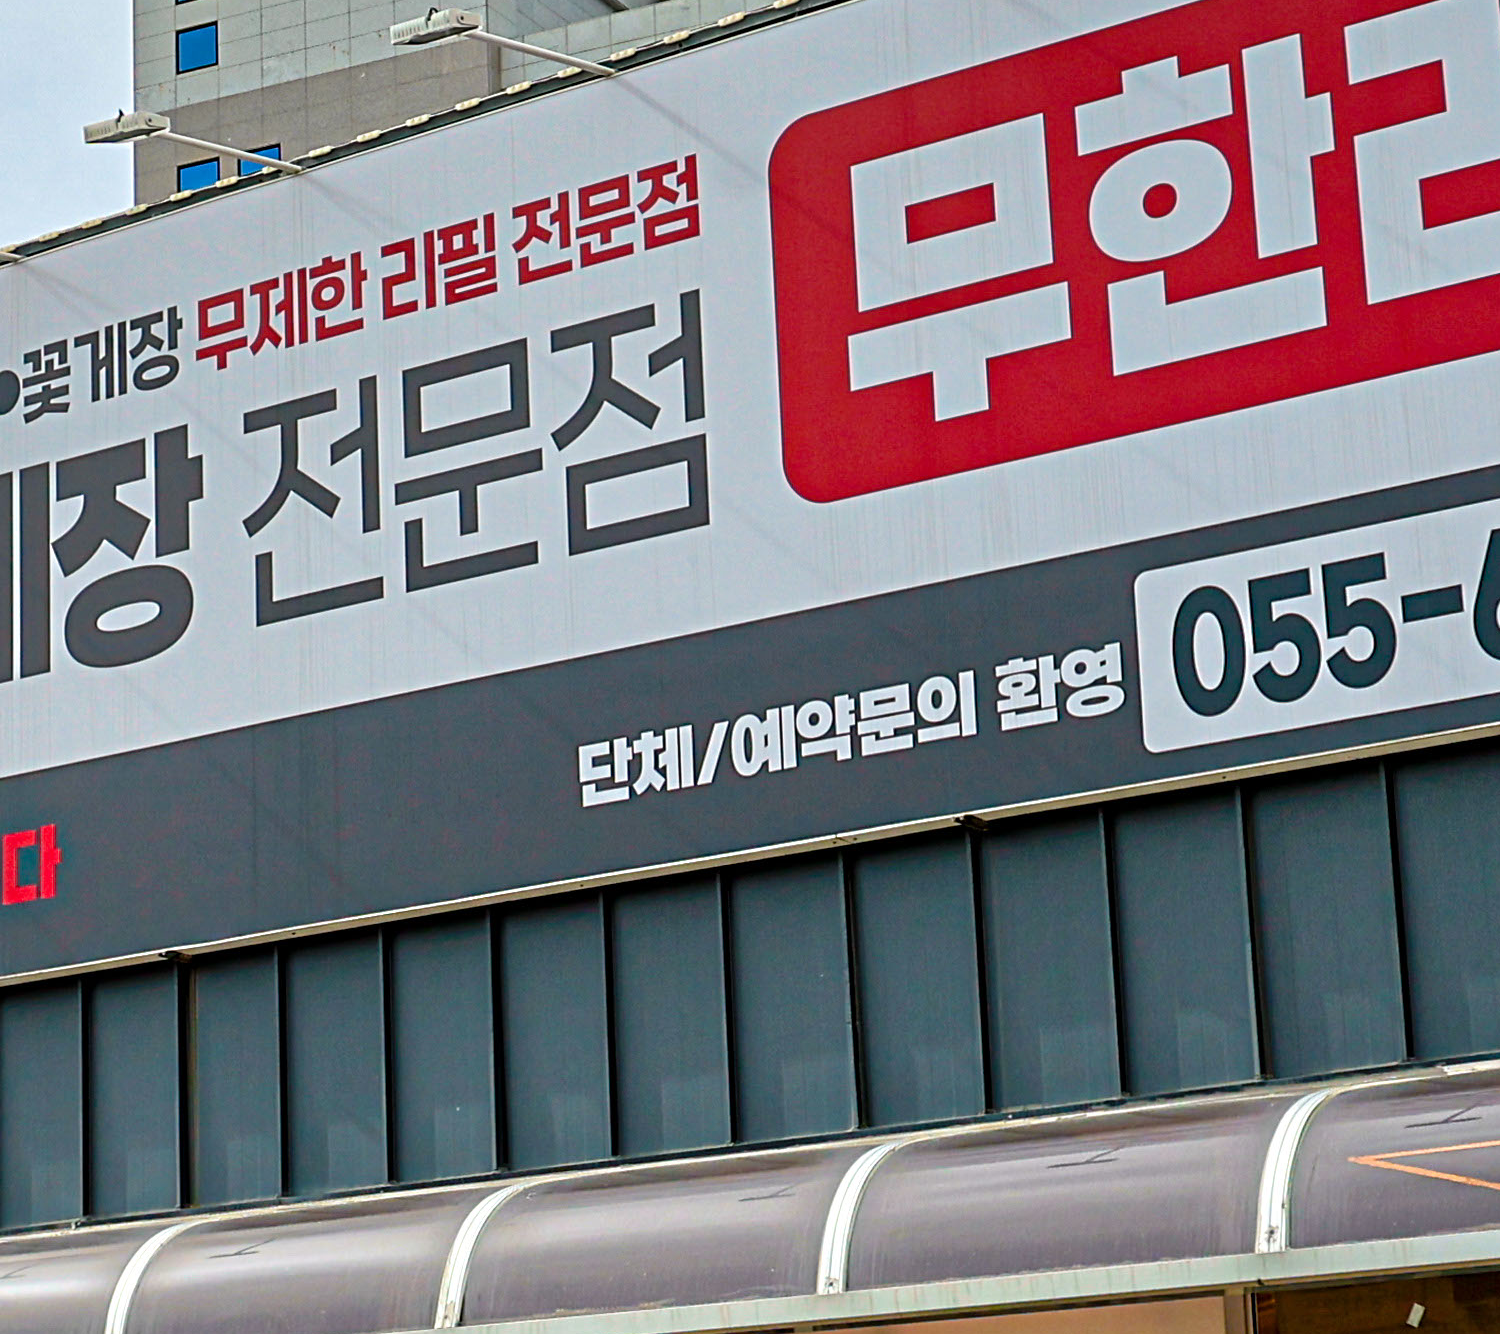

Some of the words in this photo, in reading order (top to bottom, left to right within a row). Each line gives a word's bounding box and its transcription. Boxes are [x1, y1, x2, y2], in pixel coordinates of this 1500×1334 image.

[195, 251, 369, 371] 무제한
[380, 213, 499, 321] 리필
[511, 153, 702, 285] 전문점
[241, 288, 712, 628] 전문점
[577, 670, 977, 807] 단체/예약문의
[995, 642, 1125, 731] 환영
